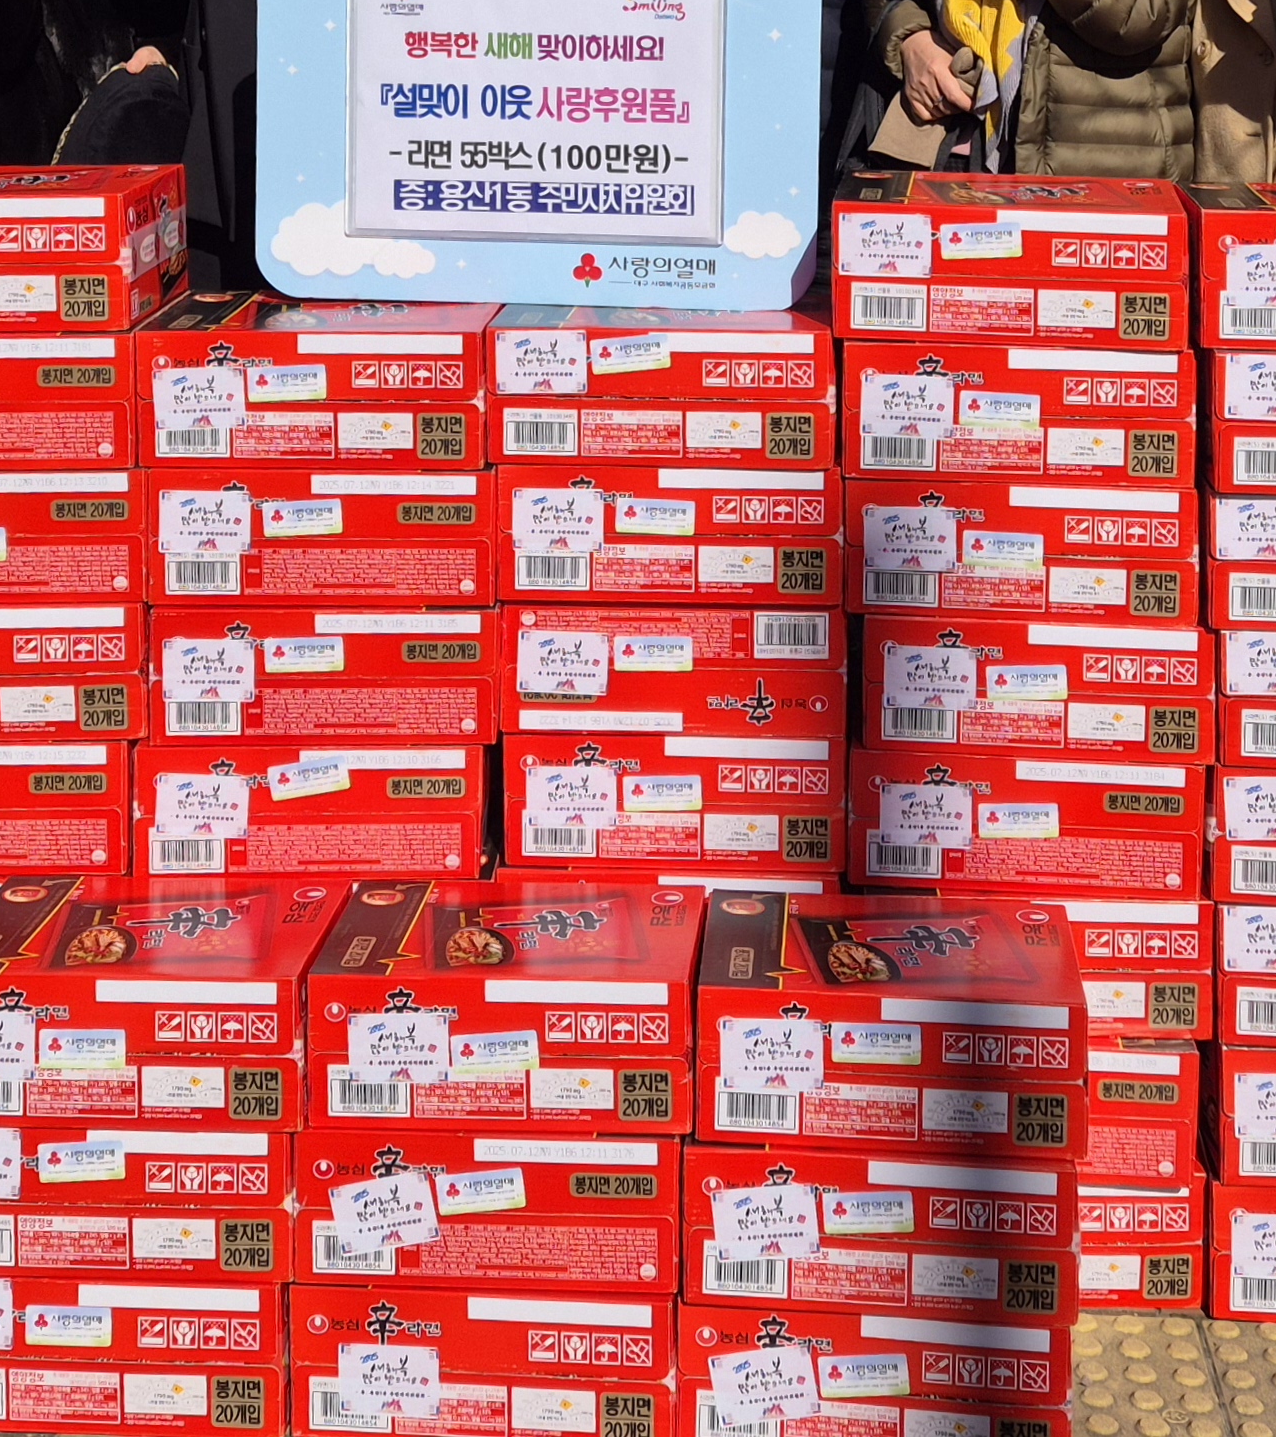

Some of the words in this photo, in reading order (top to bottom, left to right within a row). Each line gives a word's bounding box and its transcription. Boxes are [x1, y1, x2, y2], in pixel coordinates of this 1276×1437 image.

[404, 31, 479, 60] 행복한
[483, 32, 533, 60] 새해
[536, 34, 666, 62] 맞이하세요!
[480, 84, 533, 121] 이웃
[407, 139, 452, 170] 라면
[439, 180, 533, 214] 용산1동
[537, 183, 692, 215] 주민자치위원회
[607, 256, 717, 280] 사랑의열매
[64, 278, 105, 296] 봉지면
[64, 299, 105, 317] 20개입
[1124, 295, 1167, 315] 봉지면
[1123, 318, 1166, 337] 20개입
[421, 417, 462, 434] 봉지면
[769, 416, 811, 434] 봉지면
[421, 437, 462, 456] 20개입
[769, 437, 811, 456] 20개입
[402, 506, 434, 522] 봉지면
[437, 506, 472, 522] 20개입
[1153, 710, 1196, 728] 봉지면
[1153, 731, 1195, 750] 20개입
[233, 1072, 279, 1092] 봉지면
[622, 1073, 669, 1093] 봉지면
[233, 1095, 279, 1116] 20개입
[622, 1097, 669, 1118] 20개입
[575, 1176, 611, 1195] 봉지면
[614, 1177, 653, 1196] 20개입
[224, 1223, 270, 1243] 봉지면
[224, 1247, 270, 1267] 20개입
[331, 1317, 360, 1332] 농심
[364, 1302, 405, 1344] 辛
[406, 1321, 441, 1336] 라면
[215, 1380, 261, 1400] 봉지면
[215, 1404, 261, 1425] 20개입
